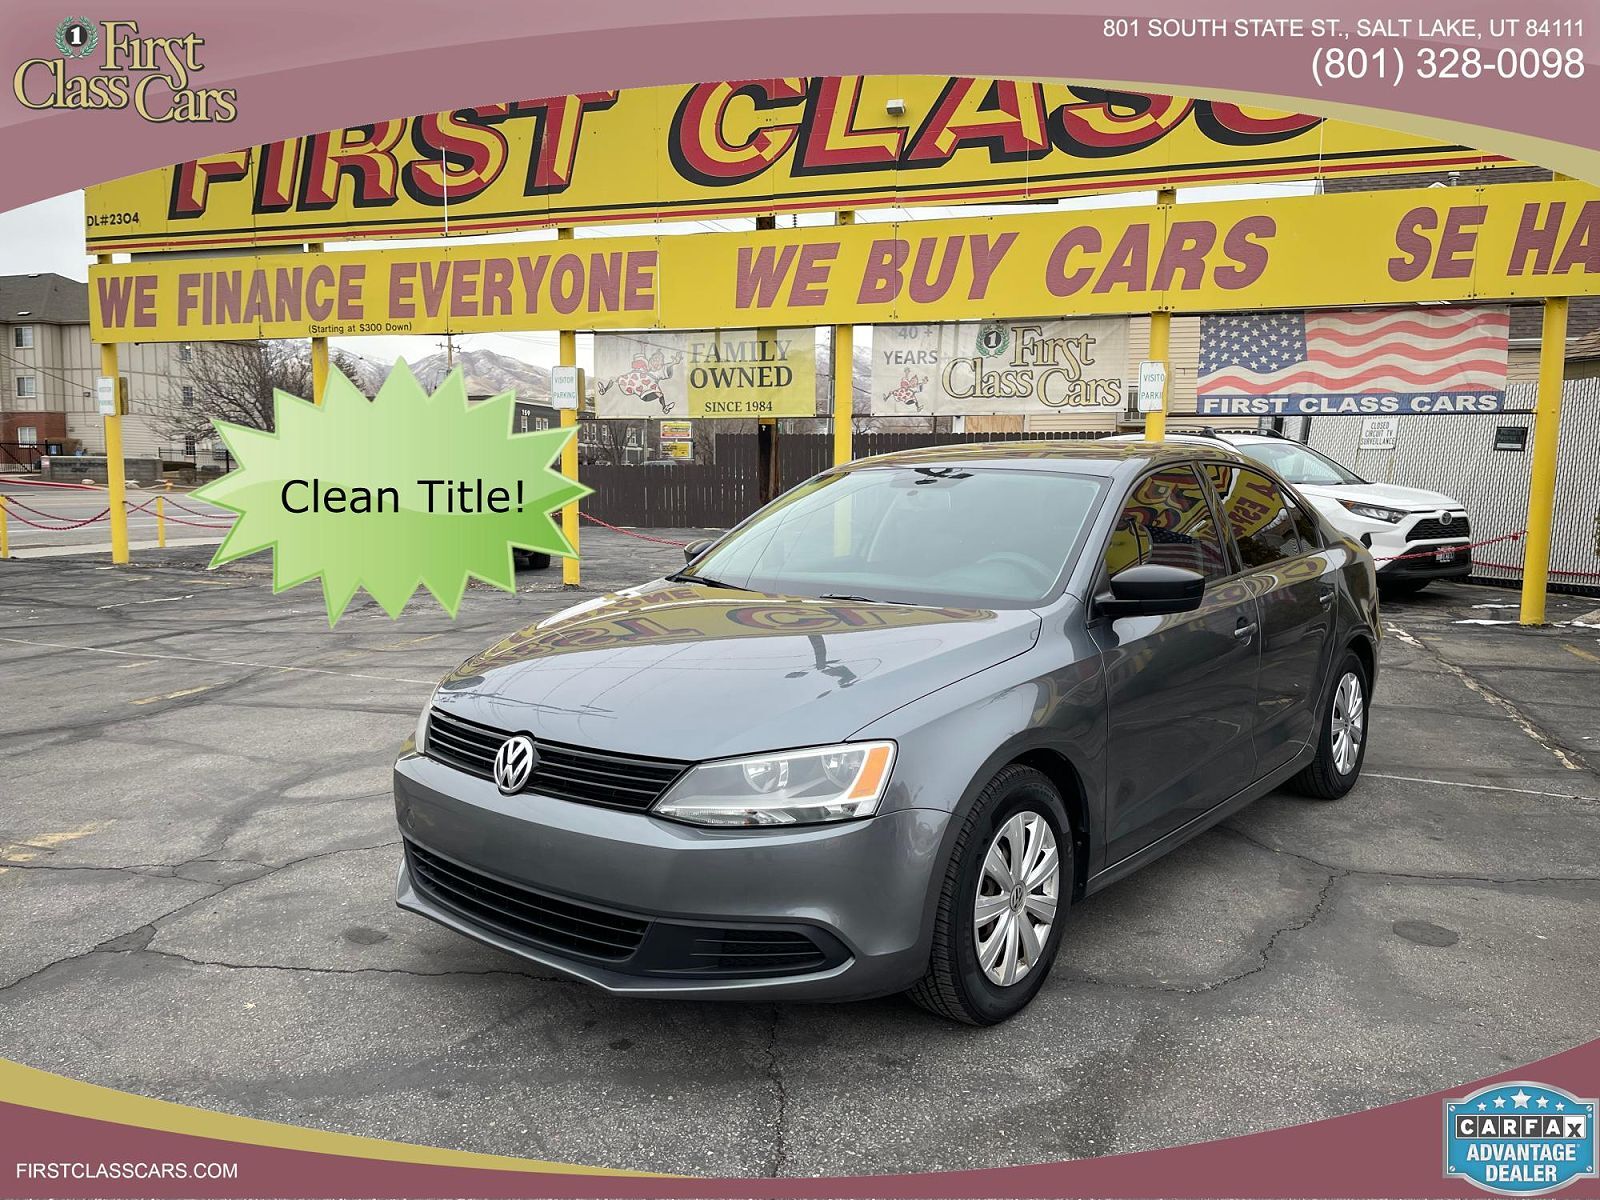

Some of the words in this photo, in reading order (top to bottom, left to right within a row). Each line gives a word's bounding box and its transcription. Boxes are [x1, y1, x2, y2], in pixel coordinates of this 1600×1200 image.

[168, 90, 620, 220] FIRST
[86, 212, 140, 227] DL#2304
[735, 242, 841, 310] WE
[856, 231, 1020, 305] BUY
[1045, 215, 1277, 298] CARS
[1387, 205, 1489, 283] SE
[97, 274, 158, 329] WE
[178, 264, 366, 327] FINANCE
[388, 250, 658, 320] EVERYONE
[308, 324, 344, 334] (Starting
[347, 325, 356, 333] at
[385, 322, 412, 332] Down)
[897, 325, 918, 340] 40
[689, 340, 793, 364] FAMILY
[883, 350, 938, 366] YEARS
[1009, 325, 1097, 382] First
[554, 376, 575, 384] VISITOR
[690, 365, 793, 389] OWNED
[941, 357, 1034, 399] Class
[1037, 367, 1122, 408] Cars
[553, 391, 576, 399] PARKING
[1203, 398, 1288, 414] FIRST
[1299, 396, 1401, 414] CLASS
[1410, 394, 1497, 412] CARS
[705, 401, 742, 413] SINCE
[745, 401, 773, 413] 1984
[1370, 421, 1390, 430] CLOSED
